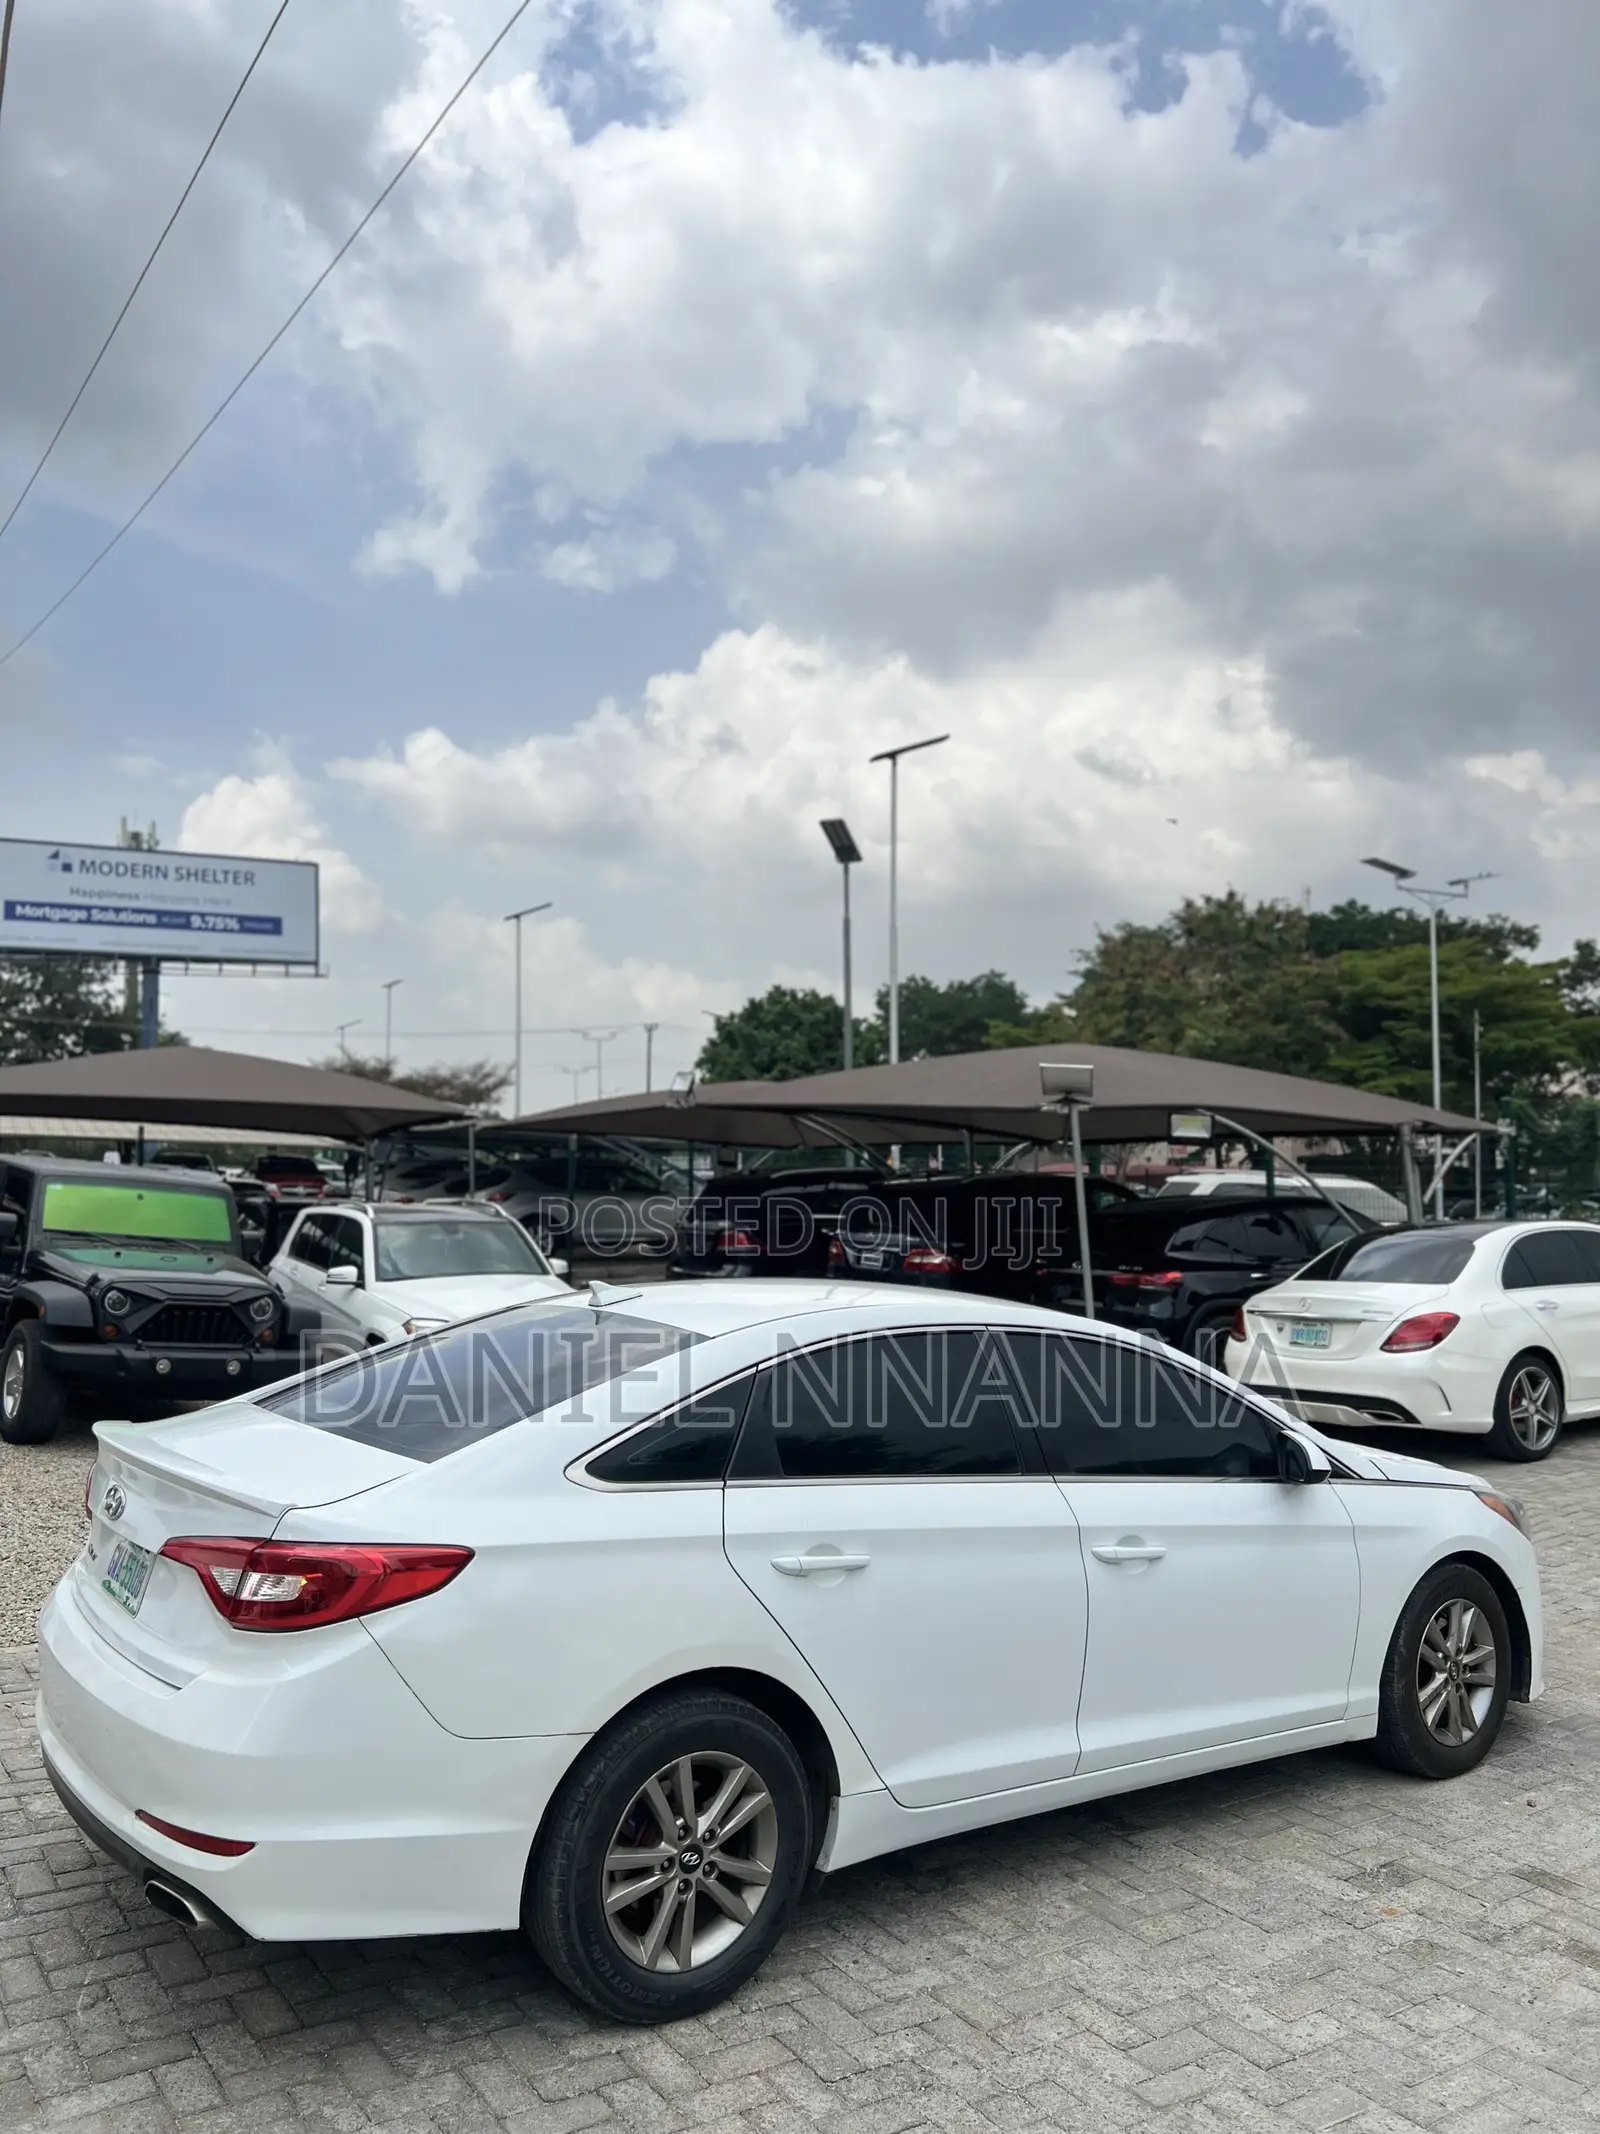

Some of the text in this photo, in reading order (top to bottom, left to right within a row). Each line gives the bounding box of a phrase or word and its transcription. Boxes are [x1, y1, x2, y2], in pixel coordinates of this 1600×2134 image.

[79, 859, 256, 886] MODERN SHELTER
[69, 886, 140, 901] Happiness
[15, 904, 88, 922] Mortgage
[90, 908, 157, 925] Solutions
[189, 914, 240, 931] 9.75%
